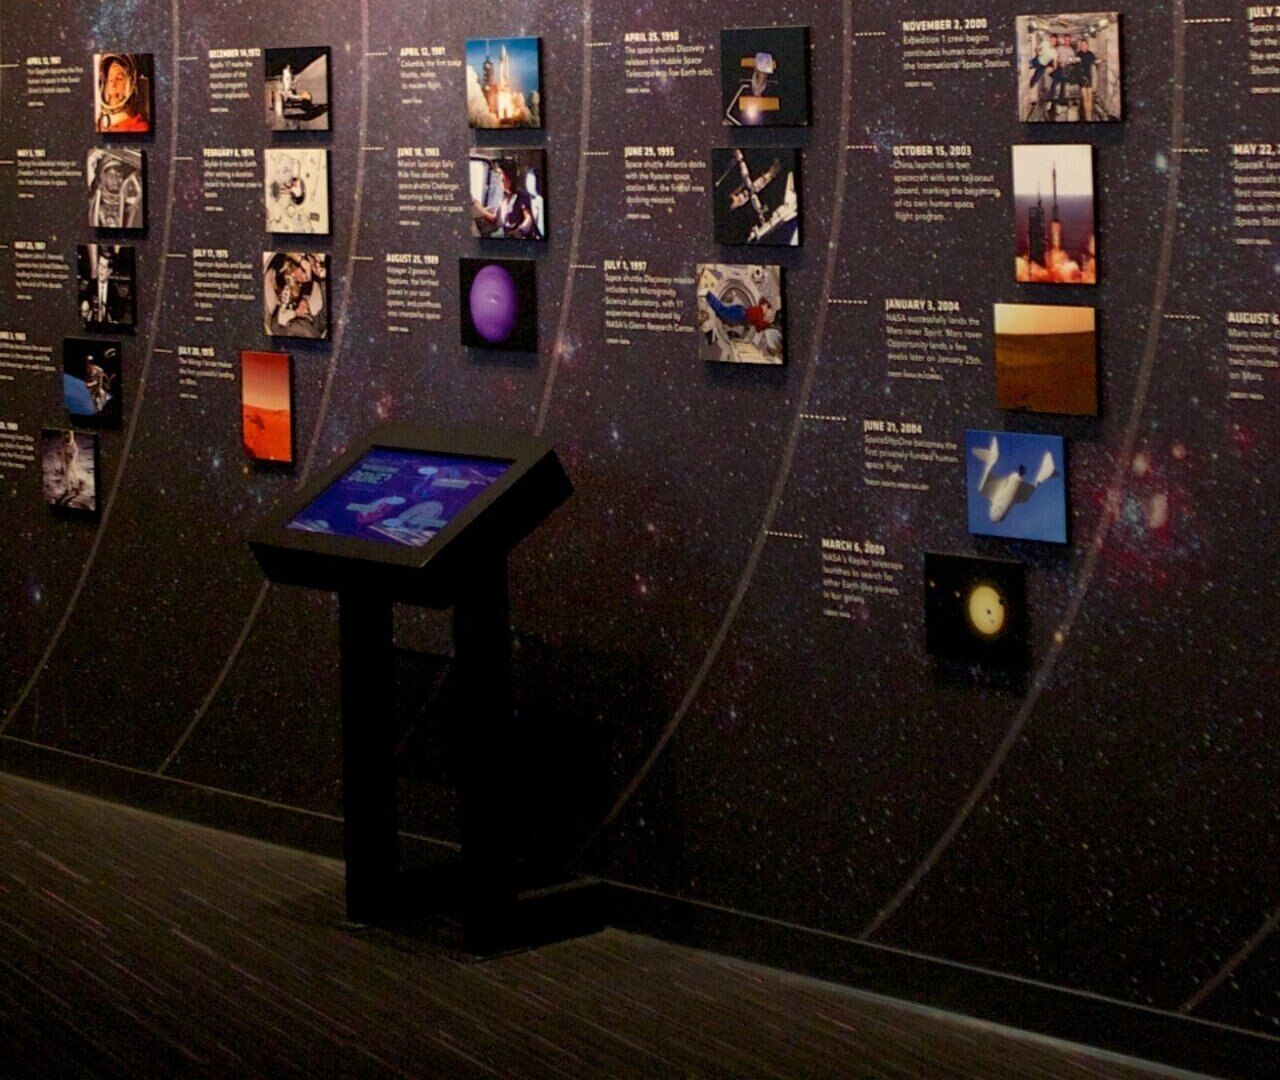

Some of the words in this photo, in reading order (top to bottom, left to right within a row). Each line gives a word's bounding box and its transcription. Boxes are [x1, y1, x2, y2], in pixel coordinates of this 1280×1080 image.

[1248, 6, 1274, 20] JULY
[902, 19, 952, 32] NOVEMBER
[954, 18, 963, 32] 2,
[965, 18, 987, 30] 2000
[892, 145, 933, 156] OCTOBER
[935, 145, 948, 157] 15,
[950, 145, 972, 156] 2003
[1234, 144, 1257, 155] MAY
[1259, 144, 1276, 156] 22,
[885, 299, 925, 313] JANUARY
[927, 300, 936, 313] 3,
[937, 300, 960, 312] 2004
[1228, 312, 1270, 325] AUGUST
[863, 420, 884, 435] JUNE
[886, 421, 899, 435] 21,
[900, 422, 922, 434] 2004
